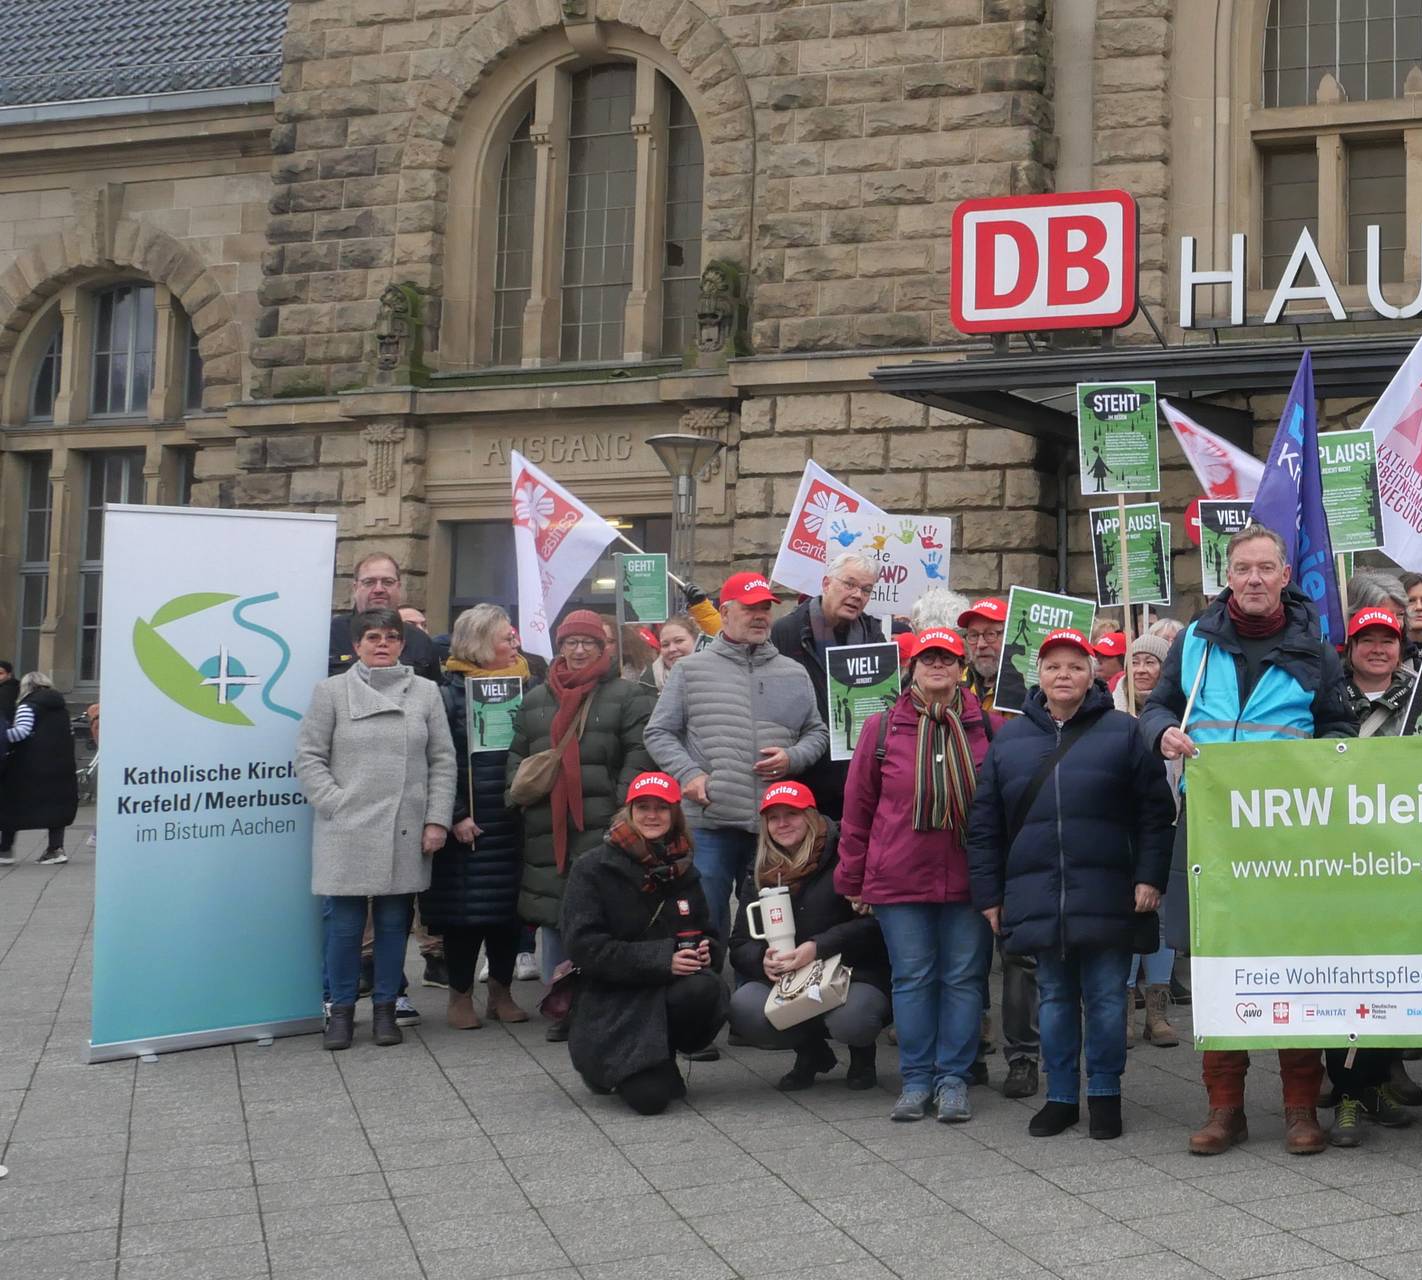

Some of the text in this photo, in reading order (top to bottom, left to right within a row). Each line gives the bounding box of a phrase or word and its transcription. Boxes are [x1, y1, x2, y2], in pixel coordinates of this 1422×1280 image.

[974, 214, 1111, 310] DB
[1093, 394, 1140, 412] STEHT!
[1096, 514, 1157, 535] APPAUS!
[1216, 509, 1246, 526] VIEL!
[628, 560, 655, 573] GEHT!
[1029, 604, 1074, 629] GEHT!
[1359, 612, 1394, 625] caritas
[920, 632, 954, 644] caritas
[846, 655, 879, 676] VIEL!
[481, 684, 507, 696] VIEL!
[123, 763, 241, 785] Katholische
[634, 776, 669, 789] caritas
[766, 786, 798, 800] caritas
[1230, 786, 1333, 828] NRW
[136, 816, 296, 842] im Bistum Aachen
[1234, 967, 1280, 985] Freie
[1243, 1009, 1262, 1018] AWO
